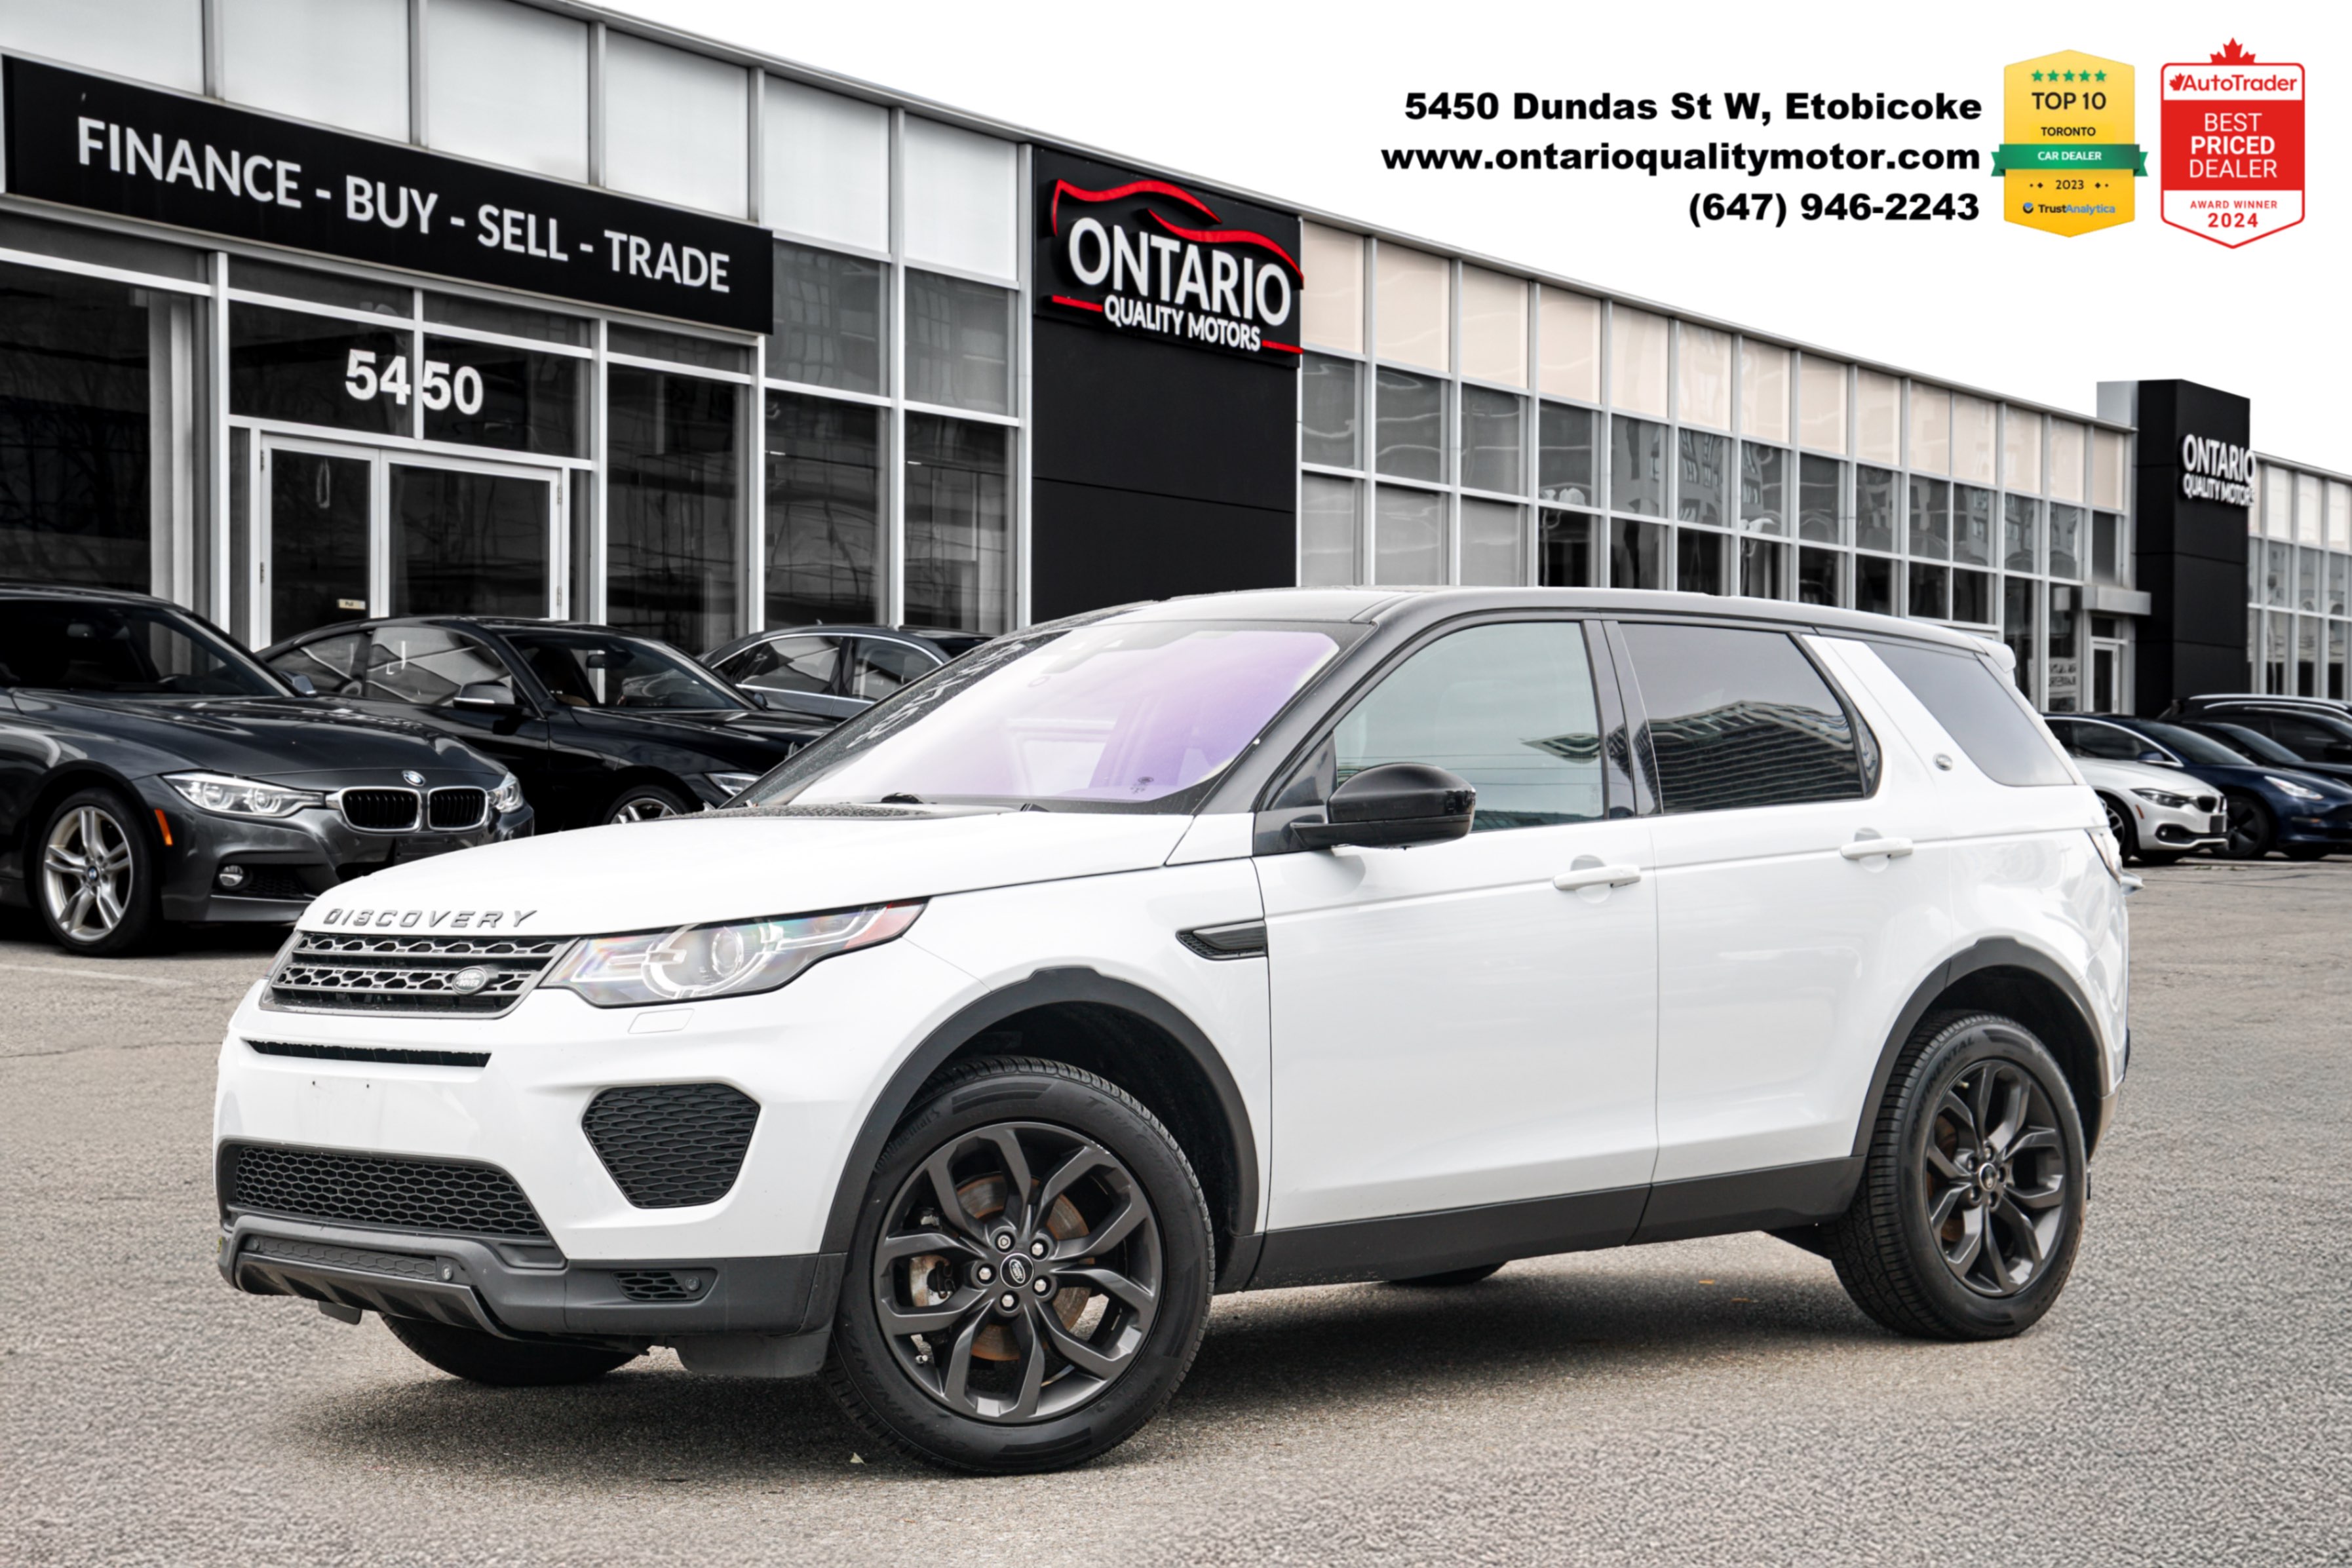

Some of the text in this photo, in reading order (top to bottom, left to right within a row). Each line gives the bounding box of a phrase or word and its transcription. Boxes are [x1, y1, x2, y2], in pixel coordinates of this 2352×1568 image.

[78, 116, 301, 208] FINANCE
[346, 175, 438, 235] BUY
[478, 204, 568, 261] SELL
[604, 229, 730, 293] TRADE
[1069, 217, 1291, 326] ONTARIO
[1104, 294, 1262, 351] QUALITY MOTORS
[345, 349, 483, 415] 5450
[2183, 434, 2256, 484] ONTARIO
[2183, 473, 2254, 507] QUALITY MOTORS
[323, 908, 538, 928] DISCOVERY
